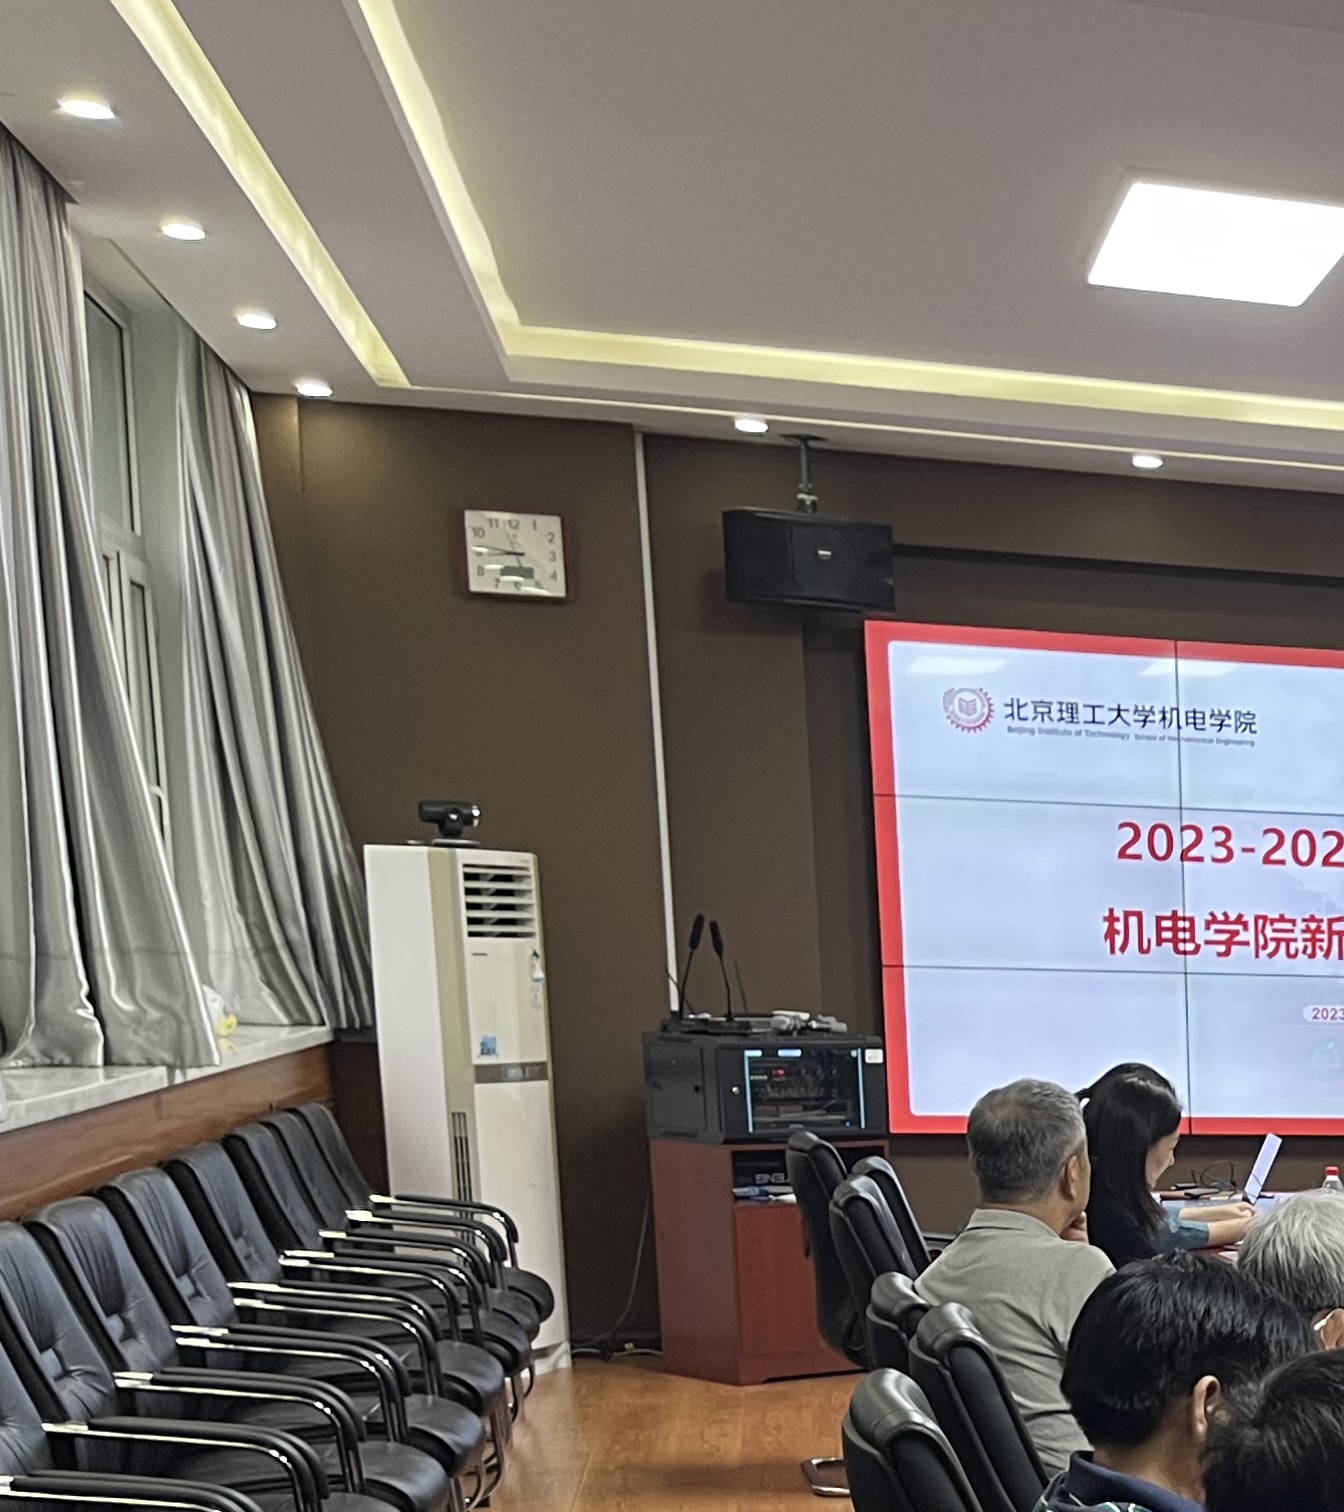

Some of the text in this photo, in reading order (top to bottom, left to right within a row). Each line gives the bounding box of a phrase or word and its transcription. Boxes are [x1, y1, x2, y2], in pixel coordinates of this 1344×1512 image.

[1004, 697, 1258, 735] 北京理工大学机电学院
